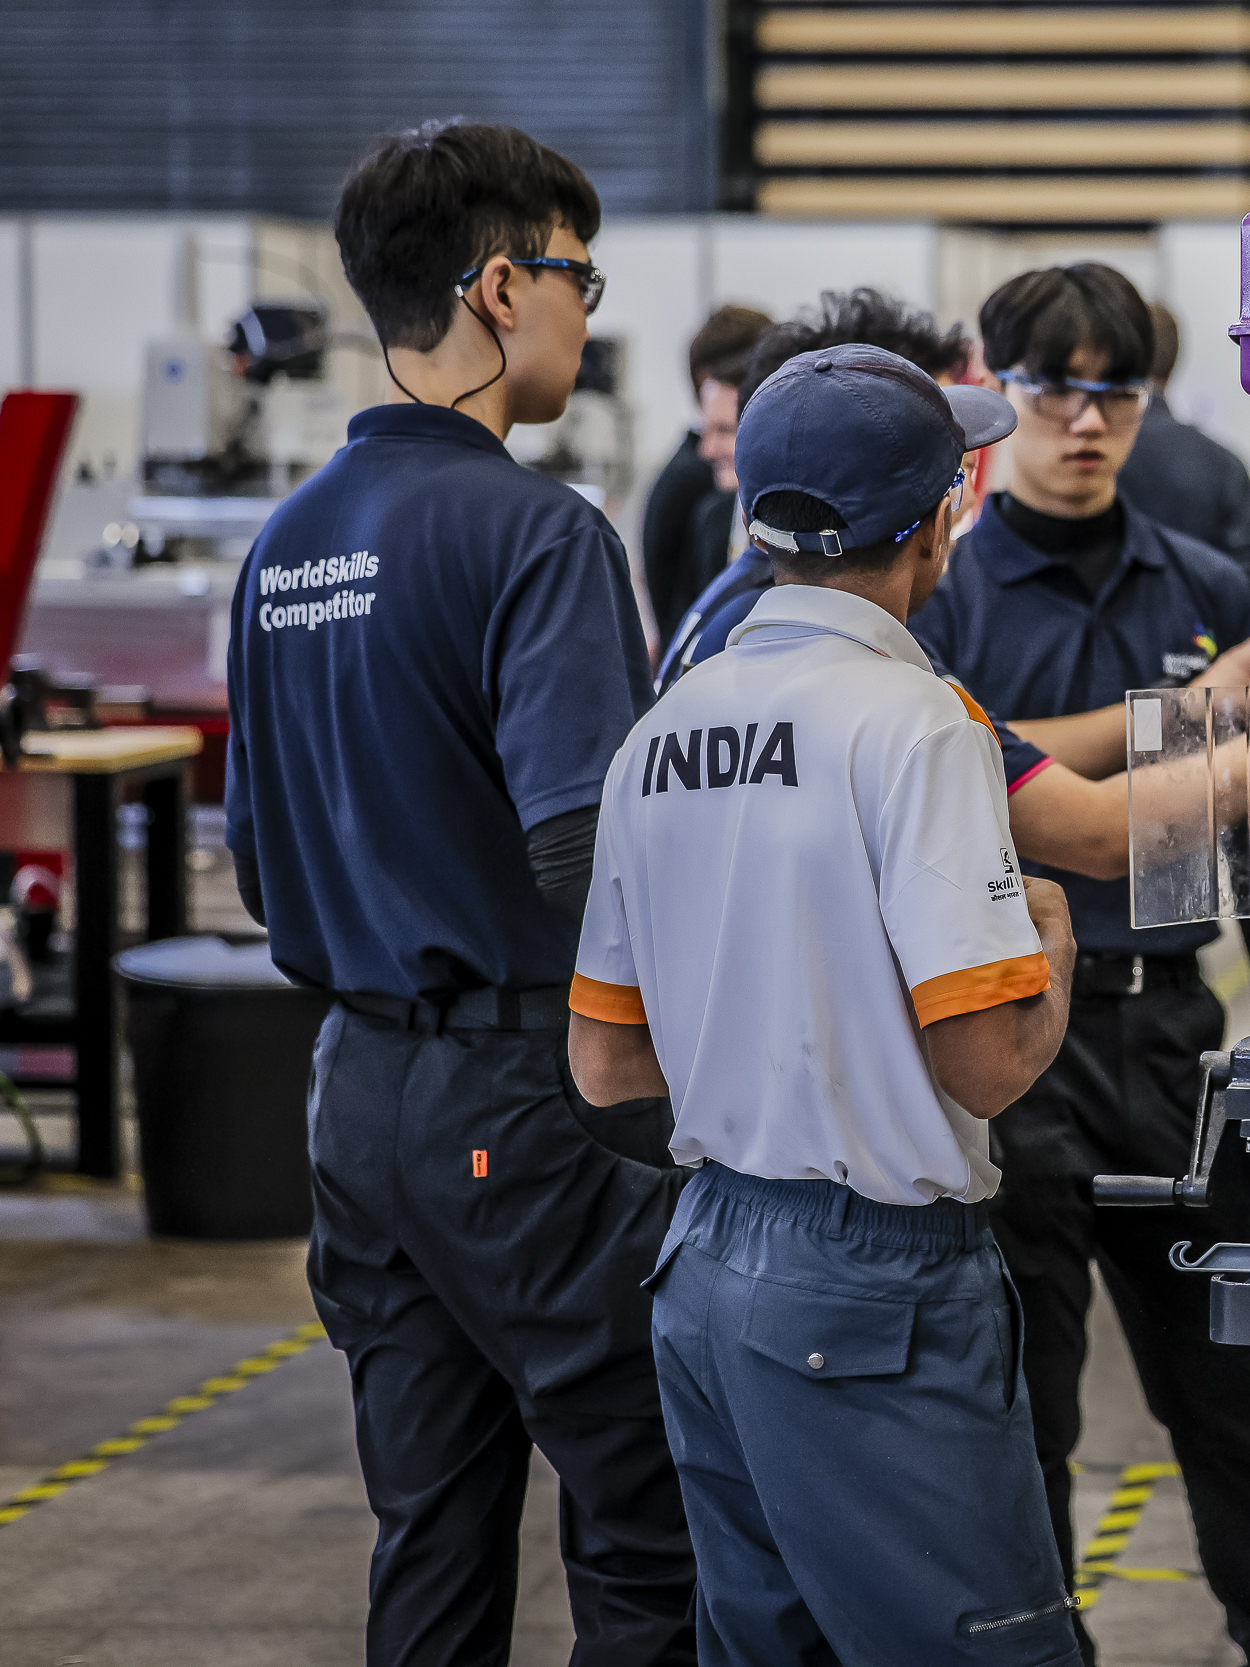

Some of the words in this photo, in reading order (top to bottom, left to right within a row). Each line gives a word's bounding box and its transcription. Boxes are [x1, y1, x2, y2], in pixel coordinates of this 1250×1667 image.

[260, 550, 379, 596] WorldSkills
[259, 589, 376, 632] Competitor
[642, 722, 799, 798] INDIA
[987, 876, 1014, 892] Skill
